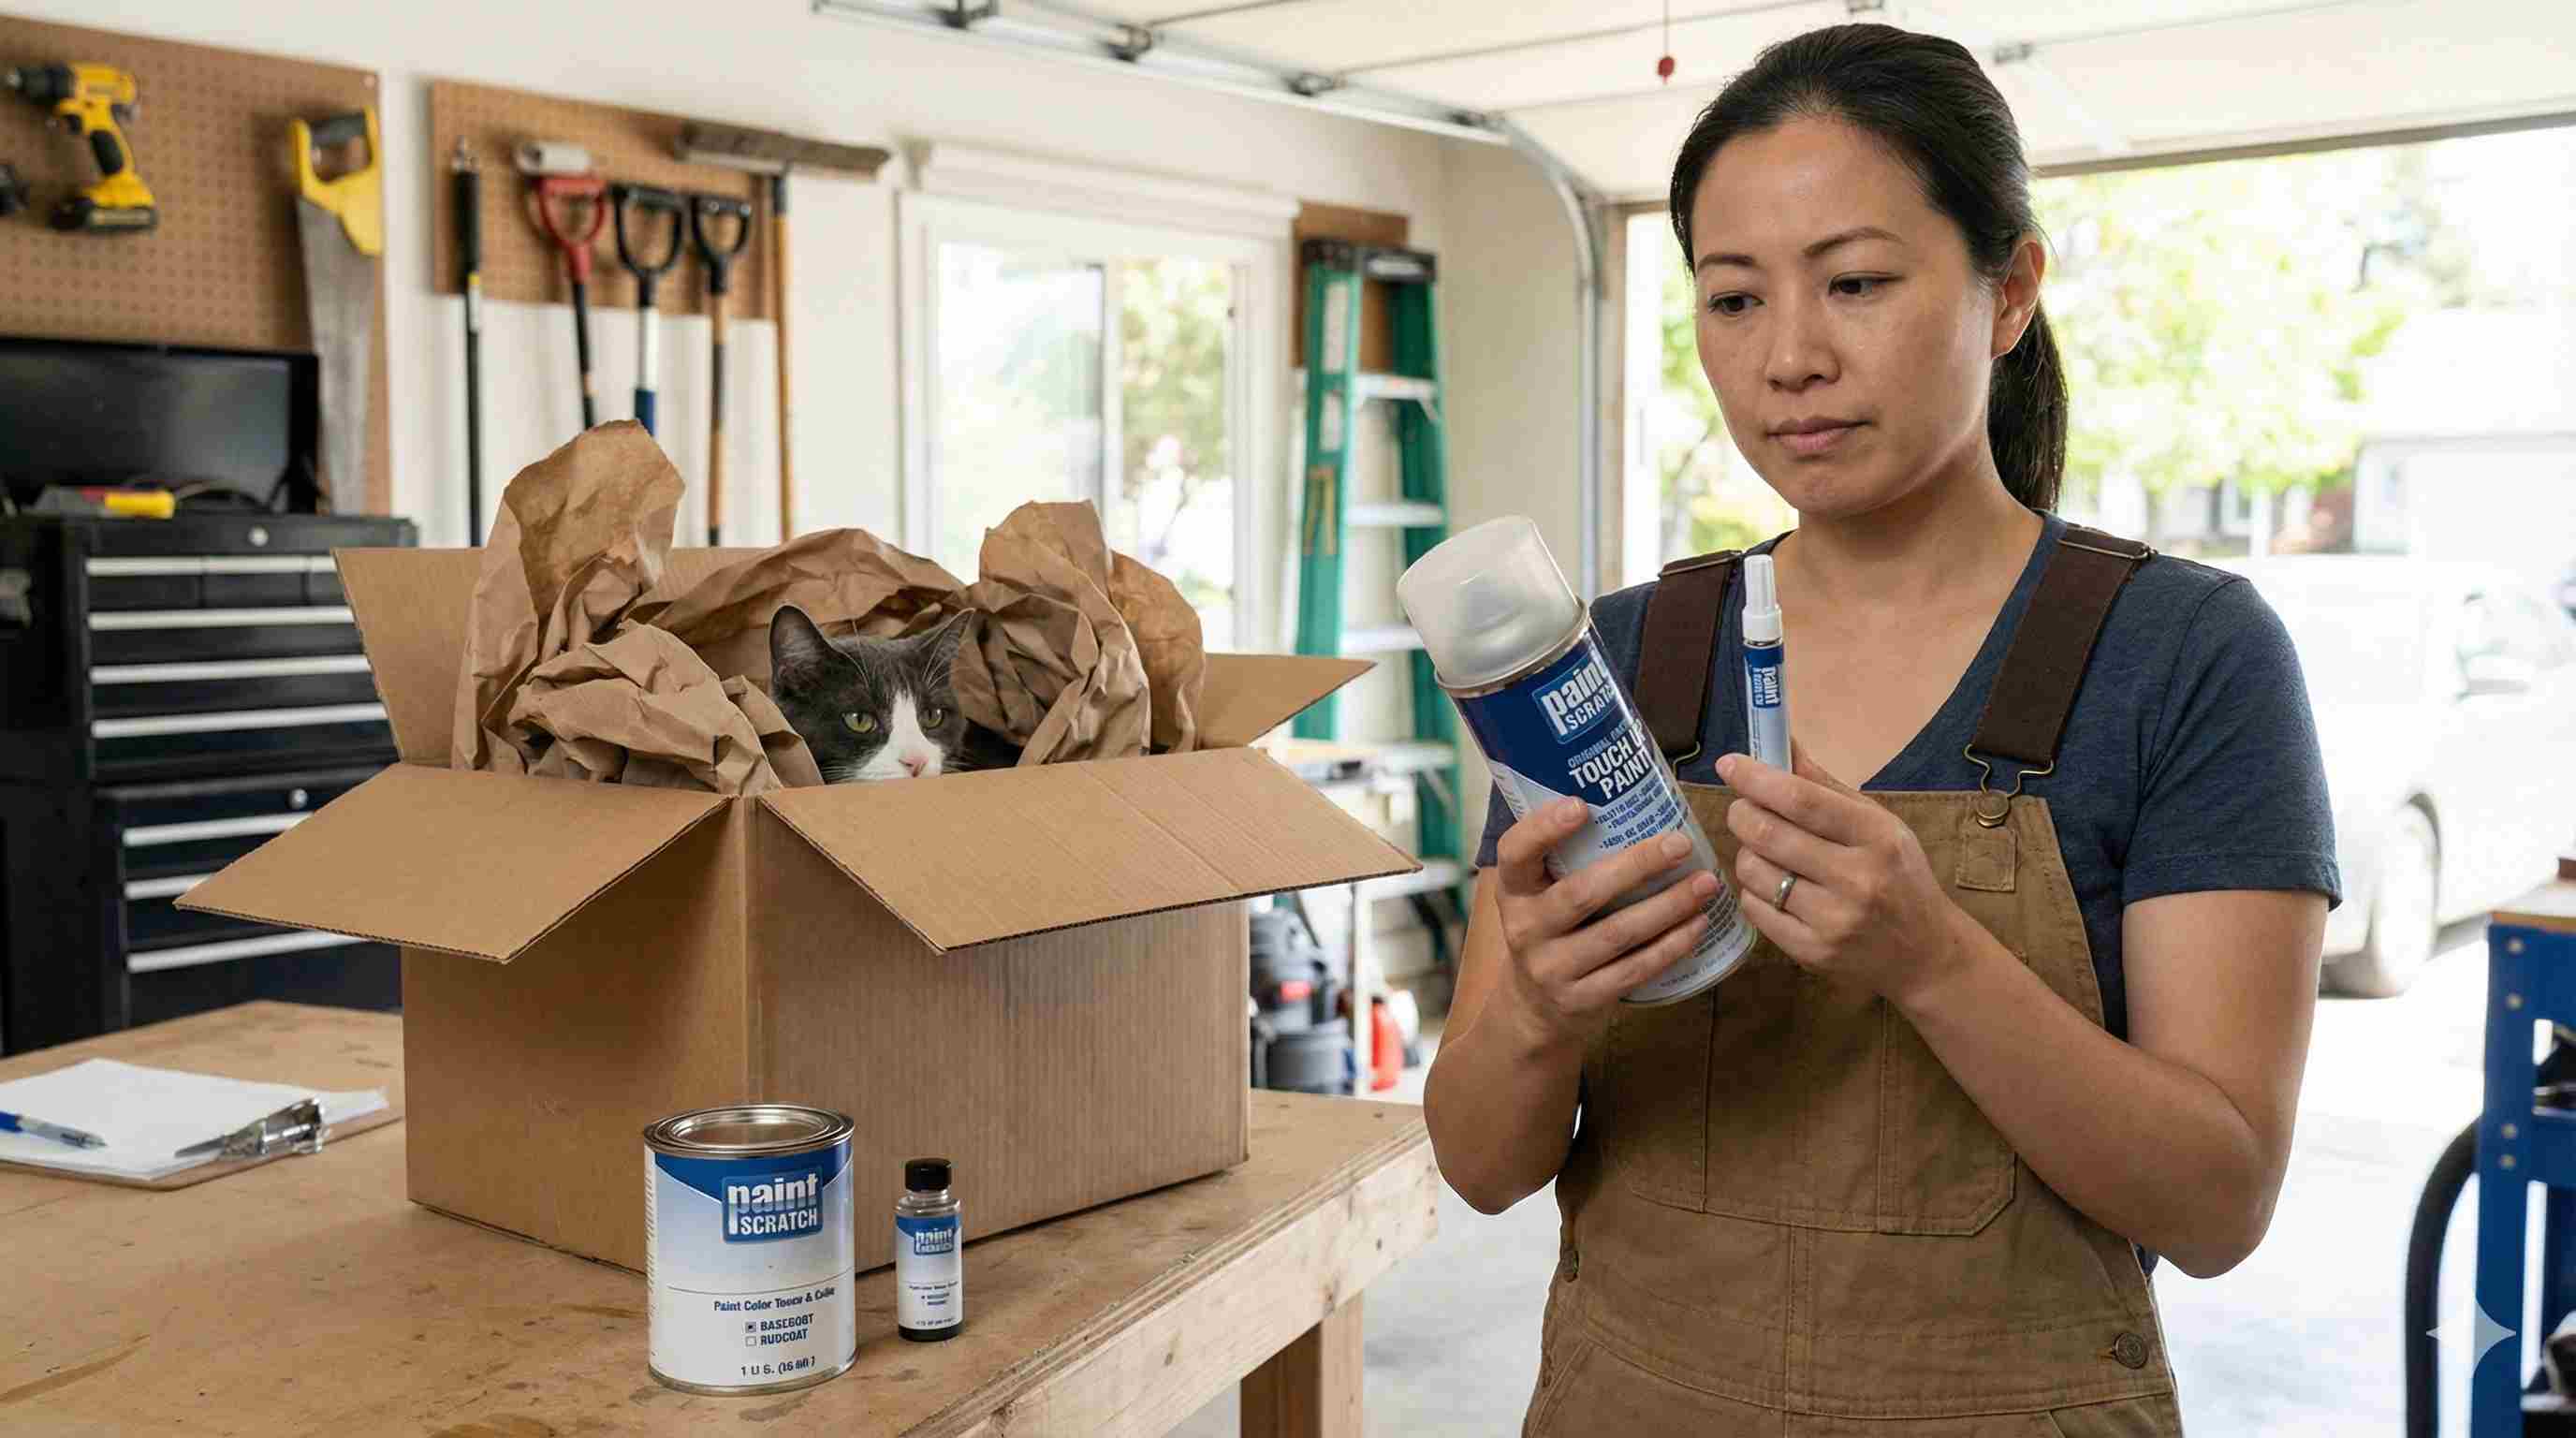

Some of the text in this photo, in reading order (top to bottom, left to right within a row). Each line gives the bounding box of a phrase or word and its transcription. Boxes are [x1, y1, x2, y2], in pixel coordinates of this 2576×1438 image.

[1569, 736, 1633, 789] TOUCH
[1599, 747, 1651, 800] PAINT
[727, 1173, 818, 1235] paint
[740, 1208, 817, 1235] SCRATCH
[714, 1300, 741, 1311] Paint
[744, 1299, 772, 1311] Color
